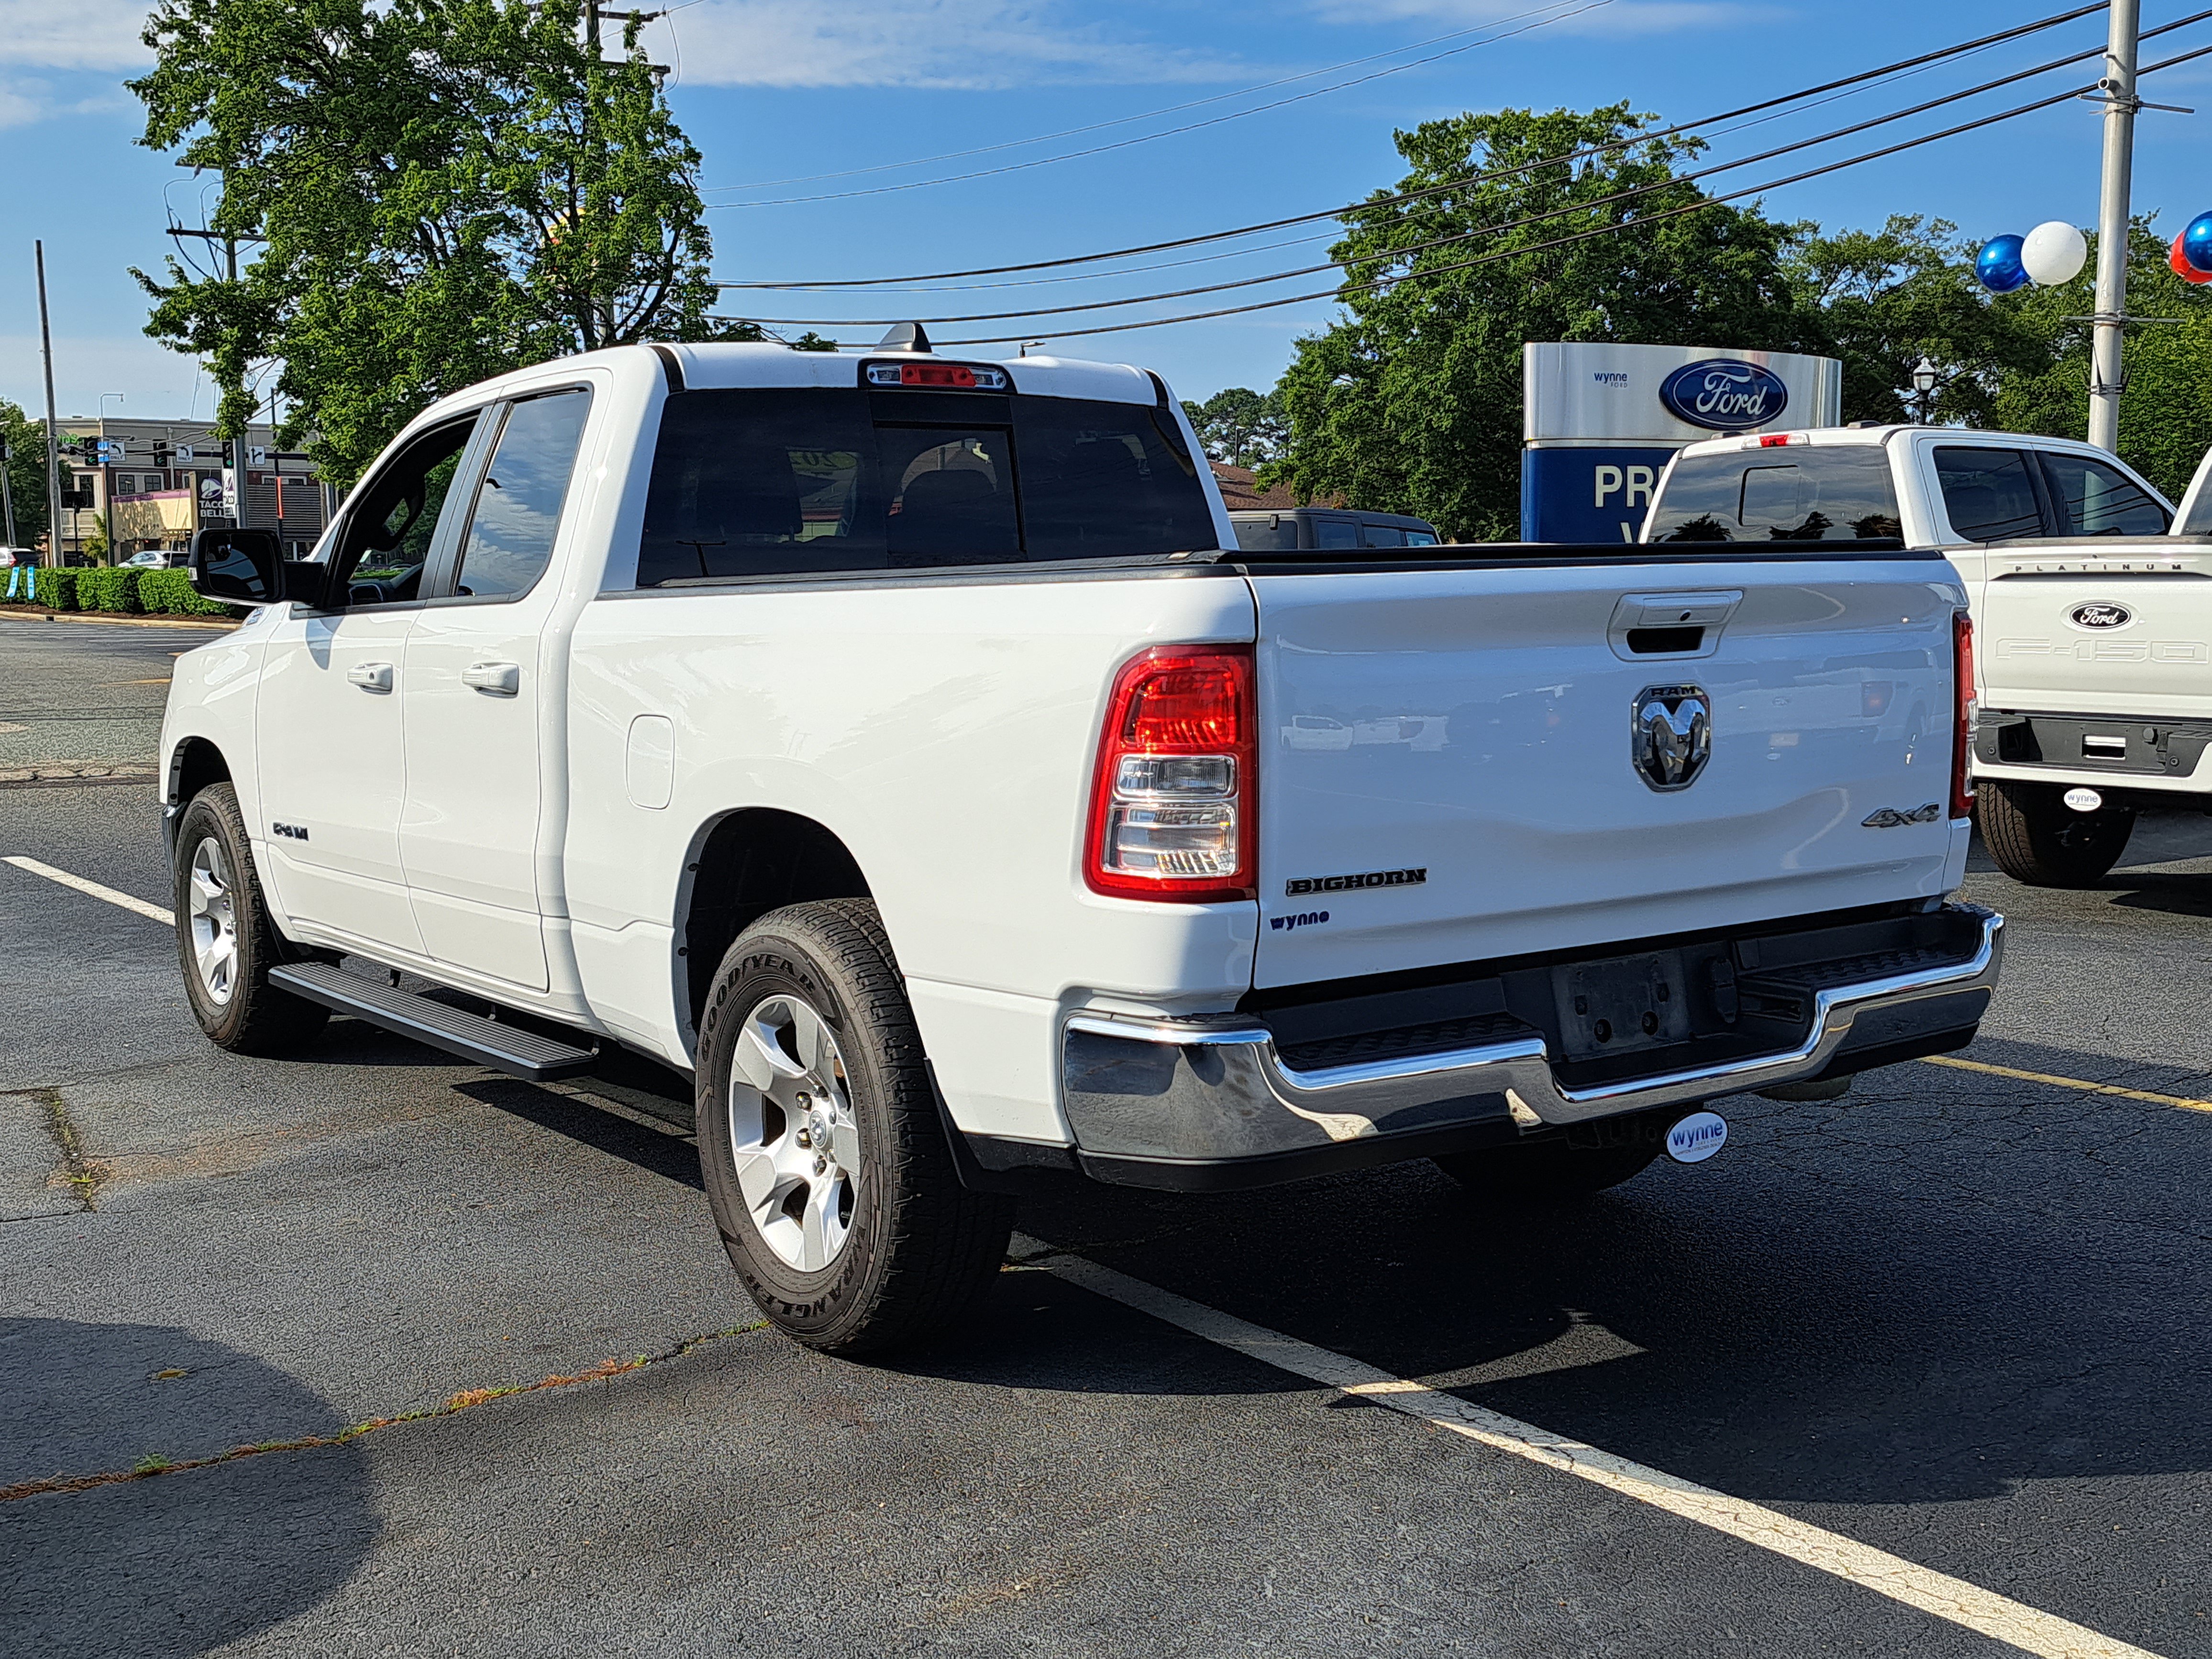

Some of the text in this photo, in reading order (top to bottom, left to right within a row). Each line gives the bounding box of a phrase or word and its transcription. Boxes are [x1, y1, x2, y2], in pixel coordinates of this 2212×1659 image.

[1594, 373, 1627, 384] wynne
[1696, 372, 1768, 415] Ford
[1595, 465, 1666, 508] PR
[199, 500, 224, 509] TACO
[2015, 563, 2182, 572] PLATINUM
[2080, 607, 2119, 624] Ford
[1995, 638, 2209, 664] F-150
[1650, 686, 1696, 697] RAM
[2068, 794, 2098, 803] wynne
[1286, 866, 1427, 896] BIGHORN
[1270, 911, 1329, 930] wynne
[1672, 1122, 1723, 1148] wynne
